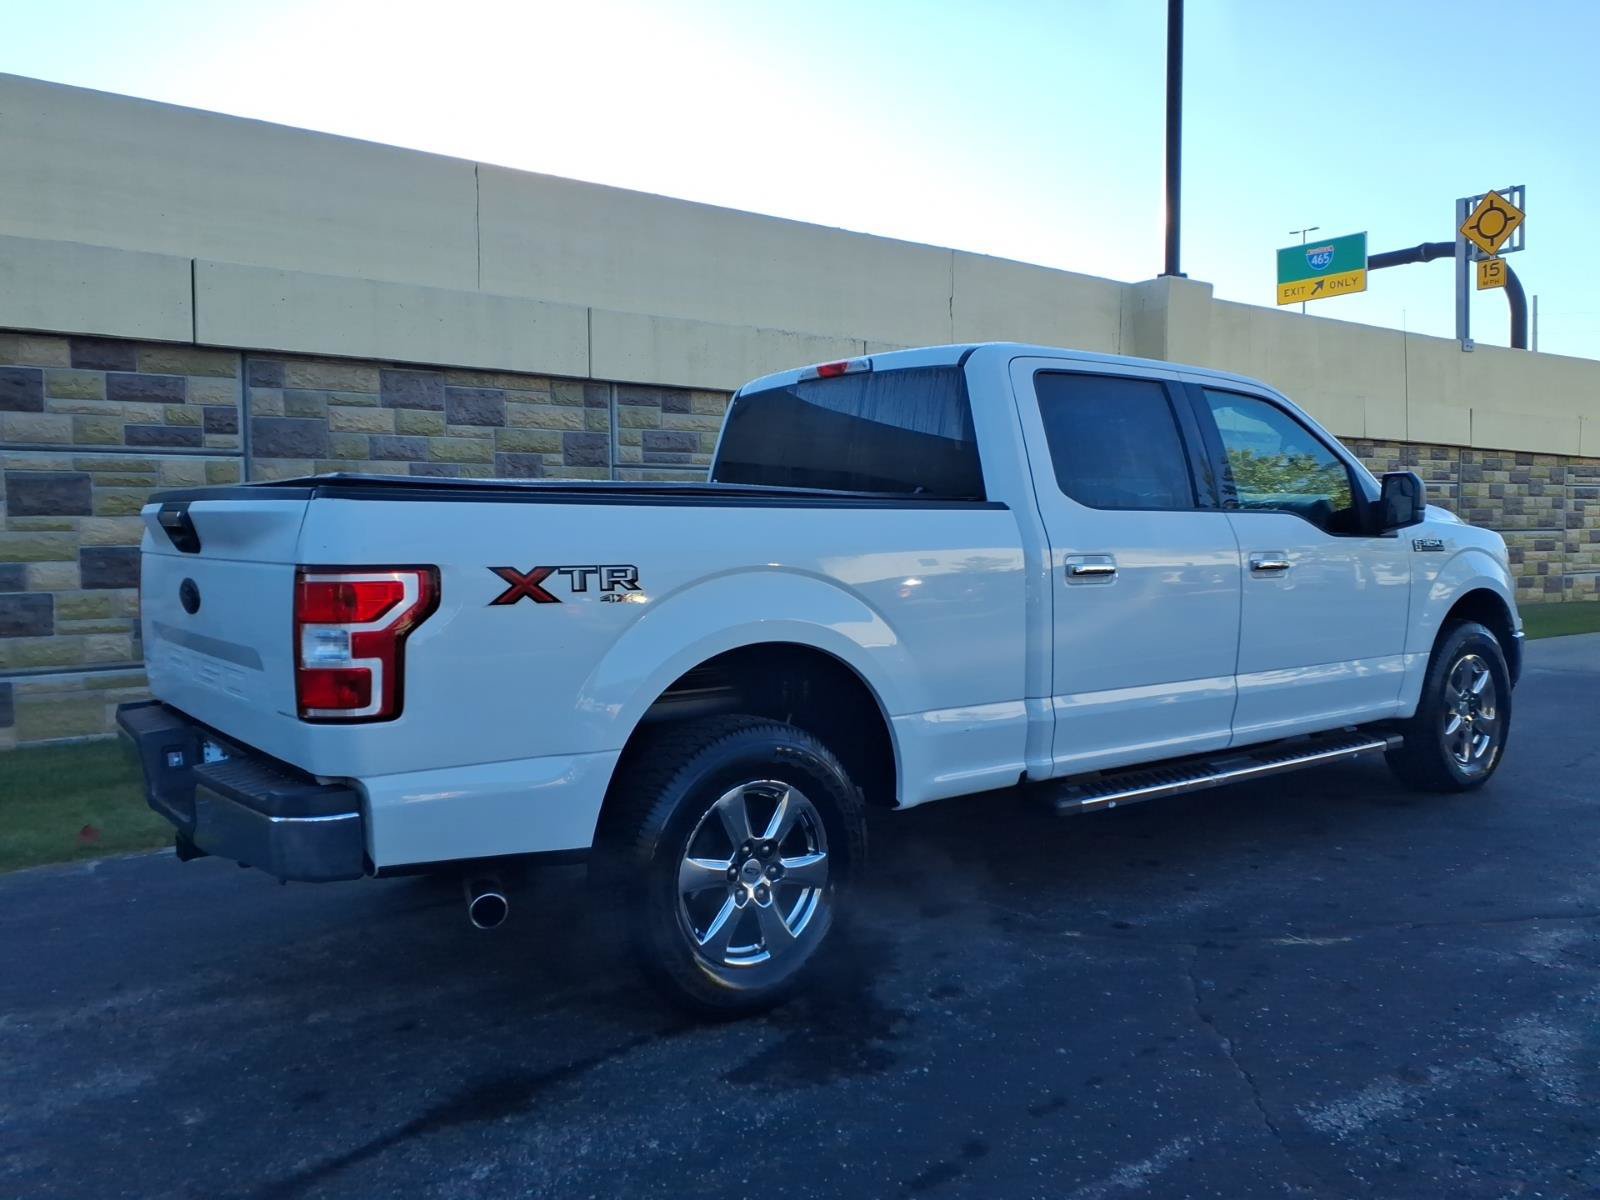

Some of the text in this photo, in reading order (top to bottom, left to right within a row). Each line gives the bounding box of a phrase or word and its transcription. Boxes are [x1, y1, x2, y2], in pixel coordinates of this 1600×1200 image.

[1312, 253, 1330, 264] 465
[1482, 262, 1500, 278] 15
[1284, 277, 1358, 297] EXIT ONLY
[486, 564, 642, 606] XTR
